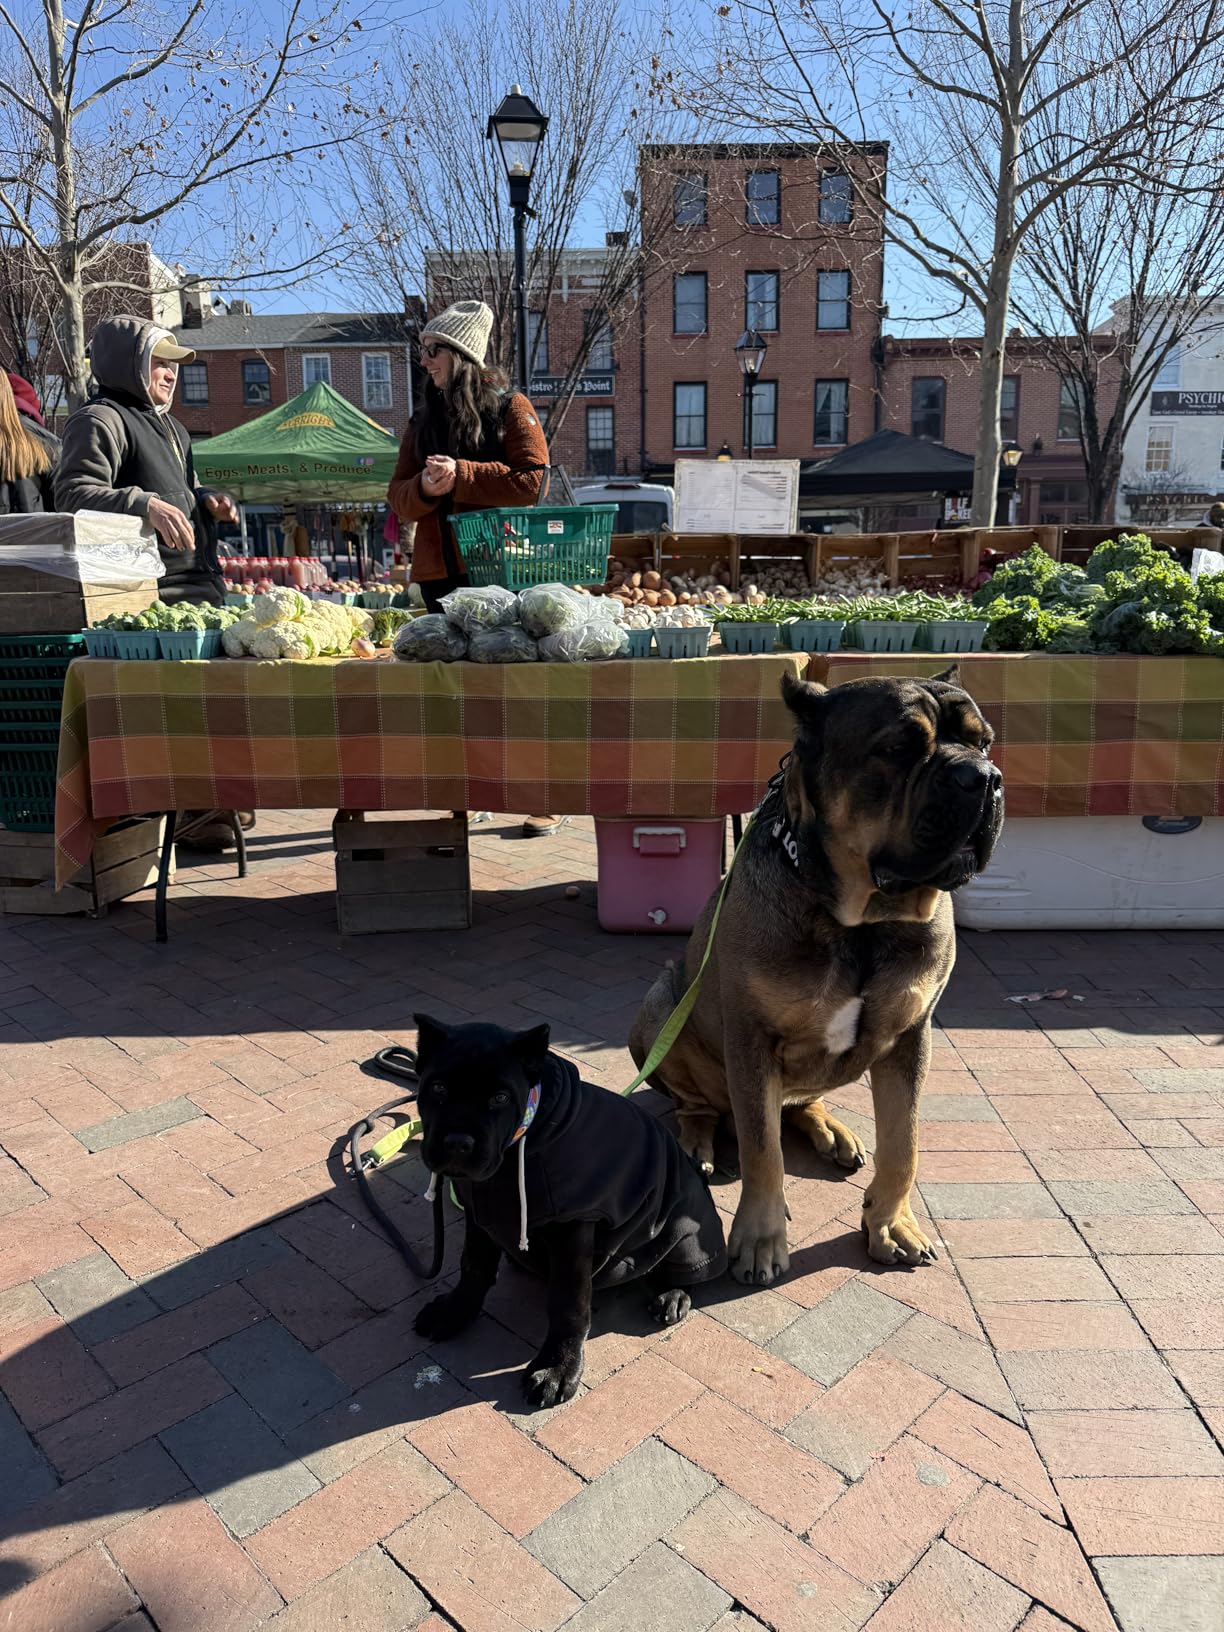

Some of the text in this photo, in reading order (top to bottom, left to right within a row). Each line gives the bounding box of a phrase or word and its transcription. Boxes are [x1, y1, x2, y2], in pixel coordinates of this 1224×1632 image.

[528, 381, 553, 392] istro
[583, 381, 610, 393] Point
[300, 463, 308, 473] &
[314, 463, 371, 475] Produce
